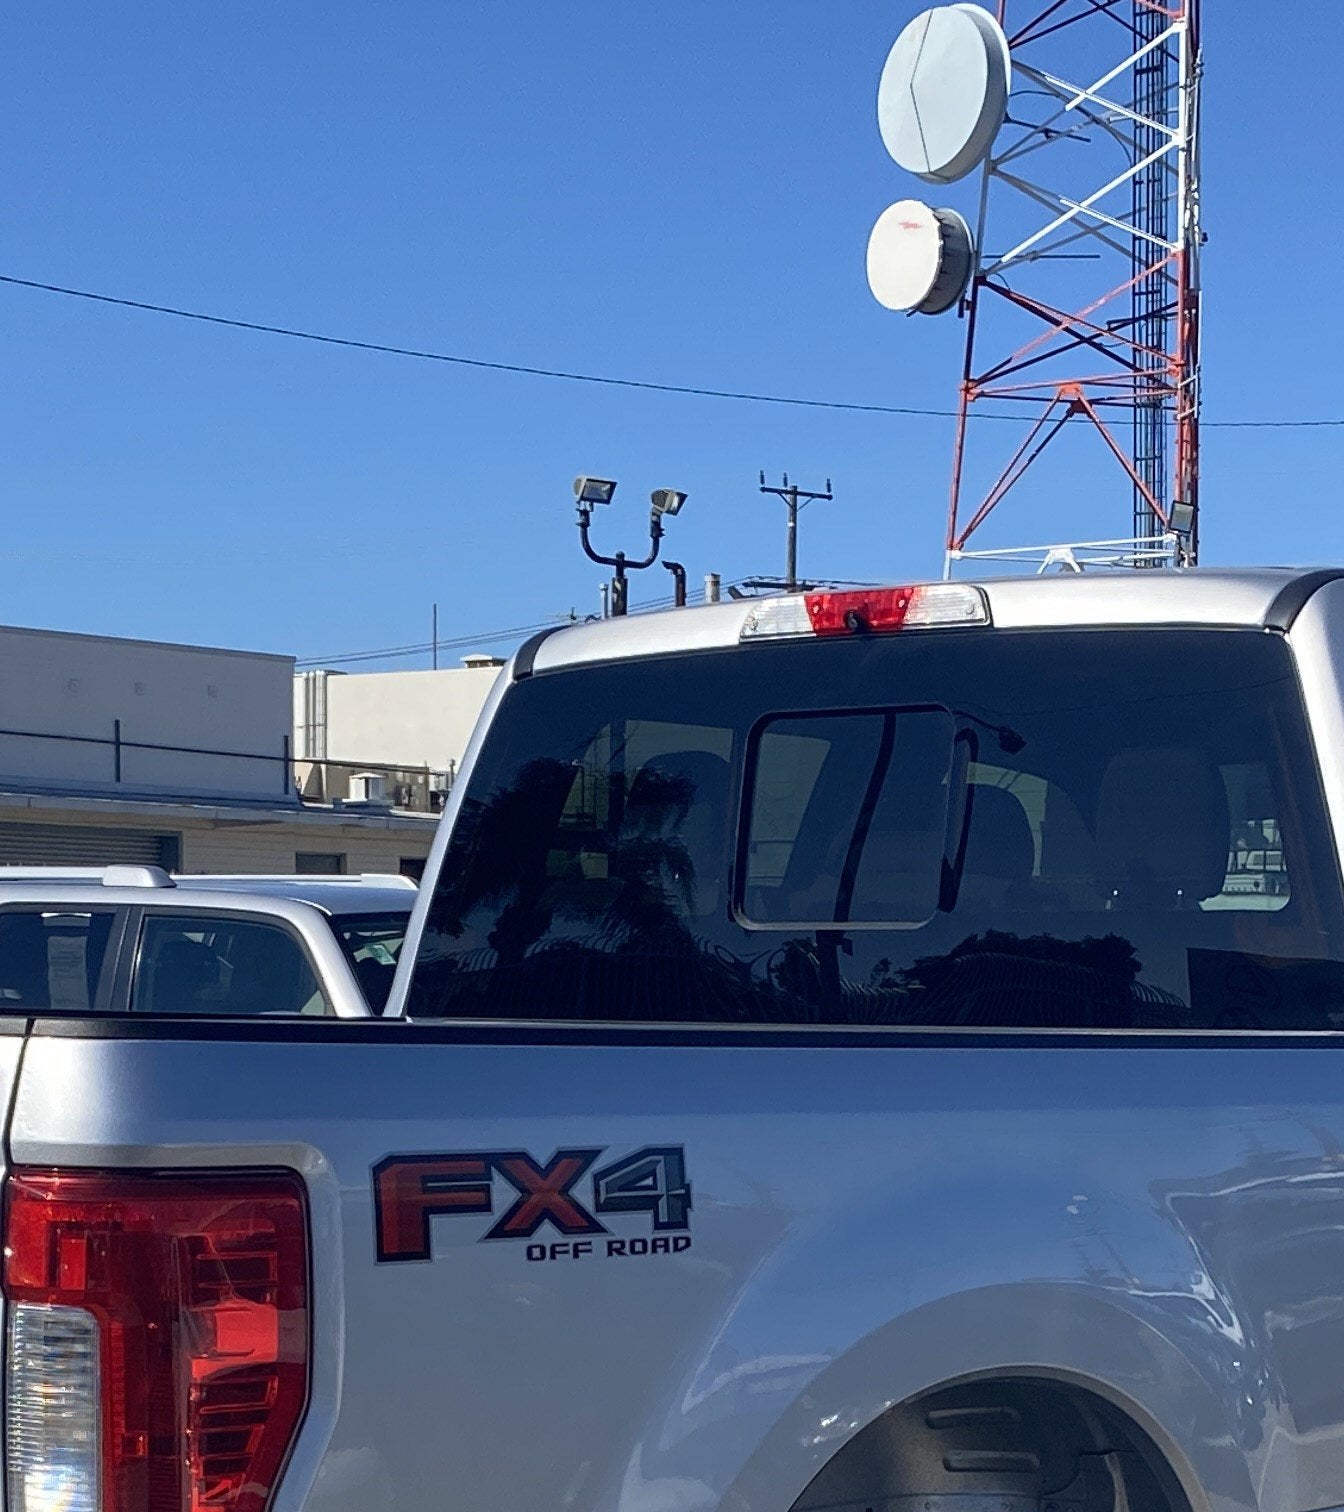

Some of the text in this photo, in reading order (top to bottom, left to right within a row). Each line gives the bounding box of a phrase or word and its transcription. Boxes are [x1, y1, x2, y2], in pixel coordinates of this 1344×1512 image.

[371, 1145, 692, 1264] FX4
[526, 1236, 692, 1261] OFF ROAD
